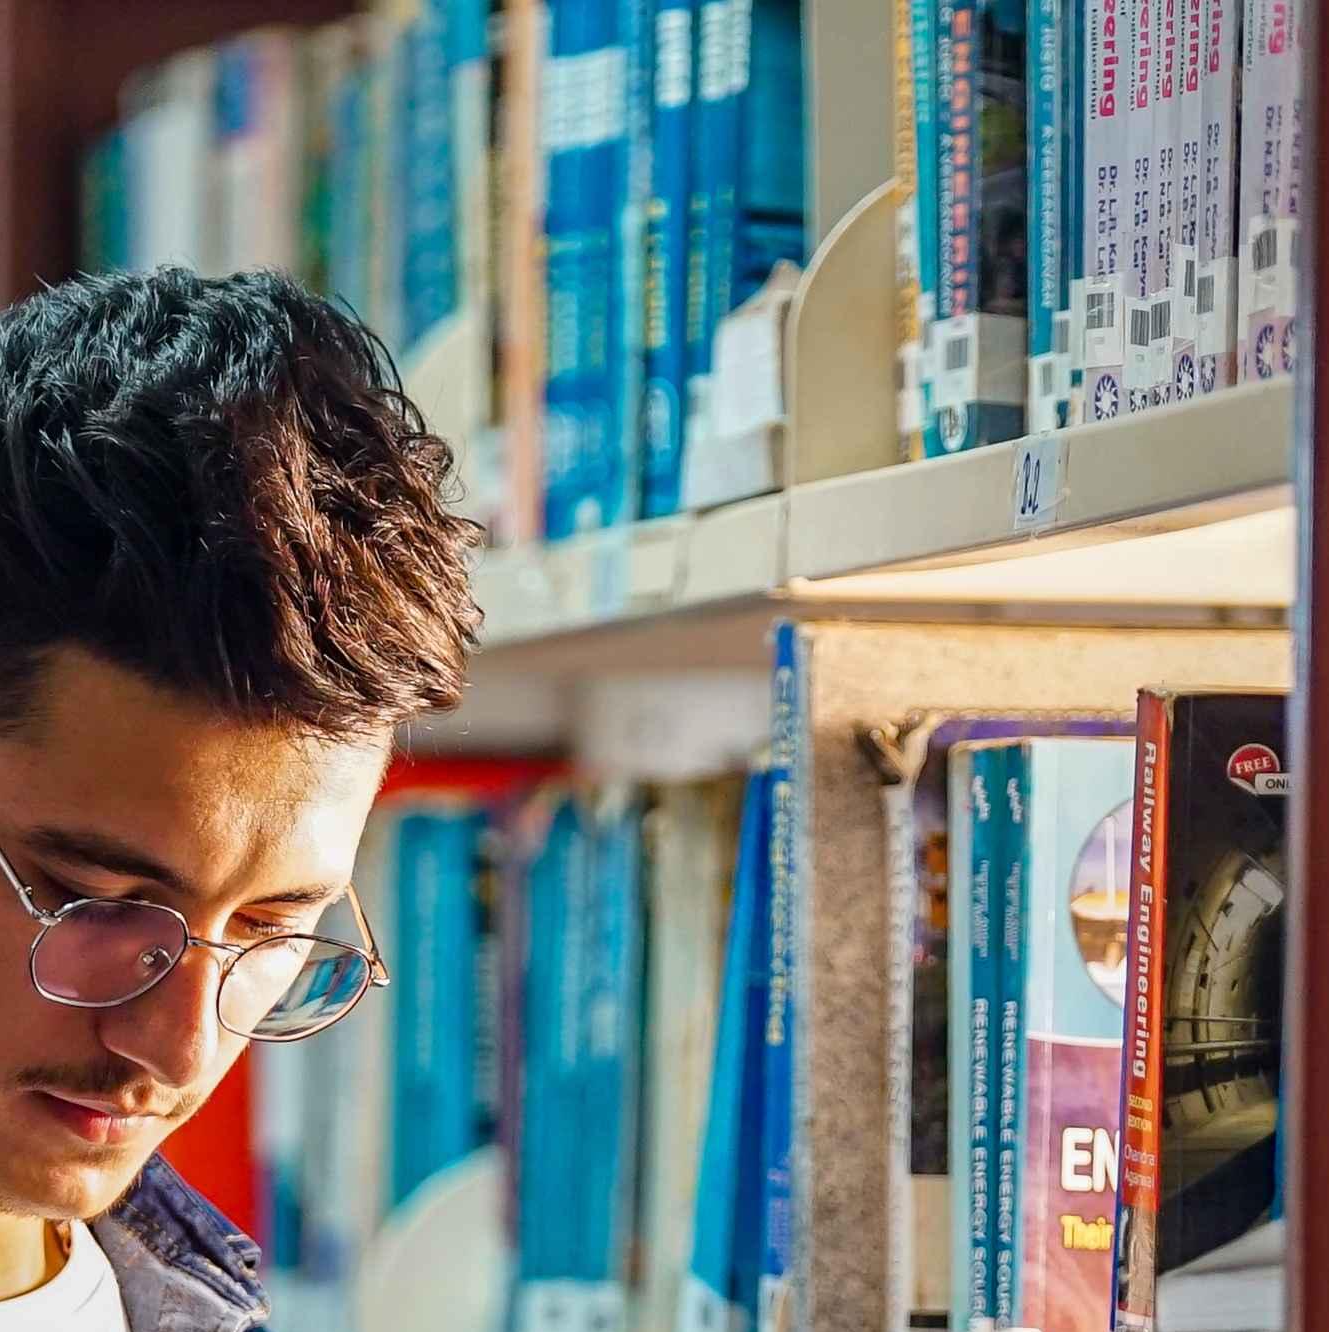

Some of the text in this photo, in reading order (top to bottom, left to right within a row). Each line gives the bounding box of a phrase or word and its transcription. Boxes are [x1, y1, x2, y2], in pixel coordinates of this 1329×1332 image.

[1136, 0, 1152, 108] ering
[1098, 167, 1107, 193] Dr.
[1109, 165, 1118, 193] Dr.
[1142, 157, 1150, 184] Dr.
[1234, 755, 1272, 775] FREE
[1132, 741, 1158, 1079] Railway Engineering
[973, 998, 989, 1140] RENEWABLE
[999, 1001, 1018, 1144] RENEWABLE
[972, 1146, 988, 1240] ENERGY
[997, 1149, 1015, 1244] ENERGY
[1060, 1127, 1120, 1193] EN
[1060, 1215, 1114, 1251] Their
